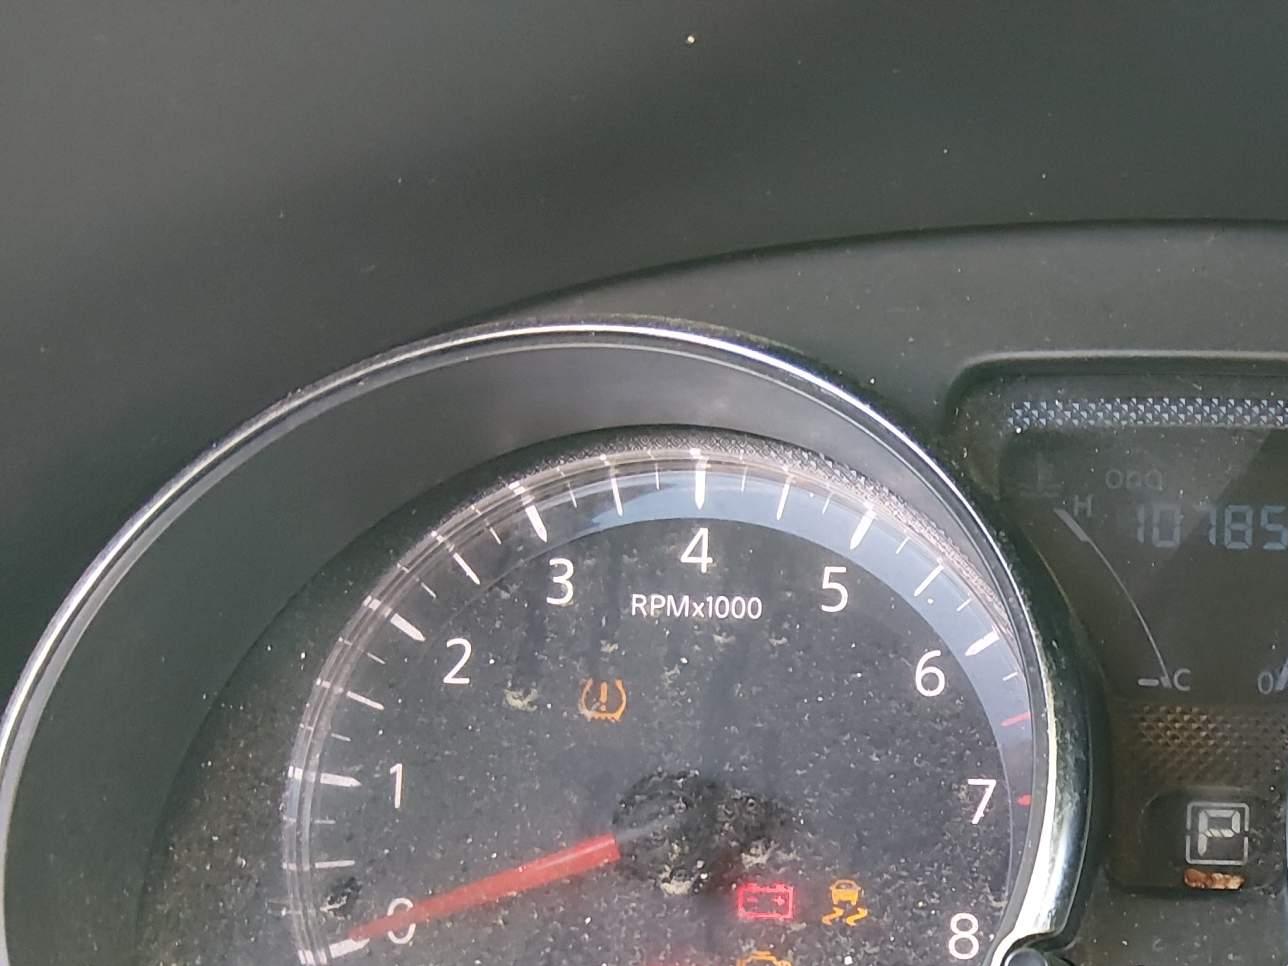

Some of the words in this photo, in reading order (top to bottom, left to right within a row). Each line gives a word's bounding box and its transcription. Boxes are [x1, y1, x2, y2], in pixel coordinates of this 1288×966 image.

[680, 528, 713, 573] 4
[546, 558, 575, 605] 3
[820, 566, 848, 612] 5
[631, 593, 763, 620] RPMx1000
[443, 638, 473, 684] 2
[915, 650, 946, 697] 6
[1173, 668, 1191, 691] C
[390, 763, 402, 808] 1
[967, 778, 997, 825] 7
[1199, 808, 1241, 856] P
[387, 897, 416, 944] 0
[948, 913, 979, 960] 8
